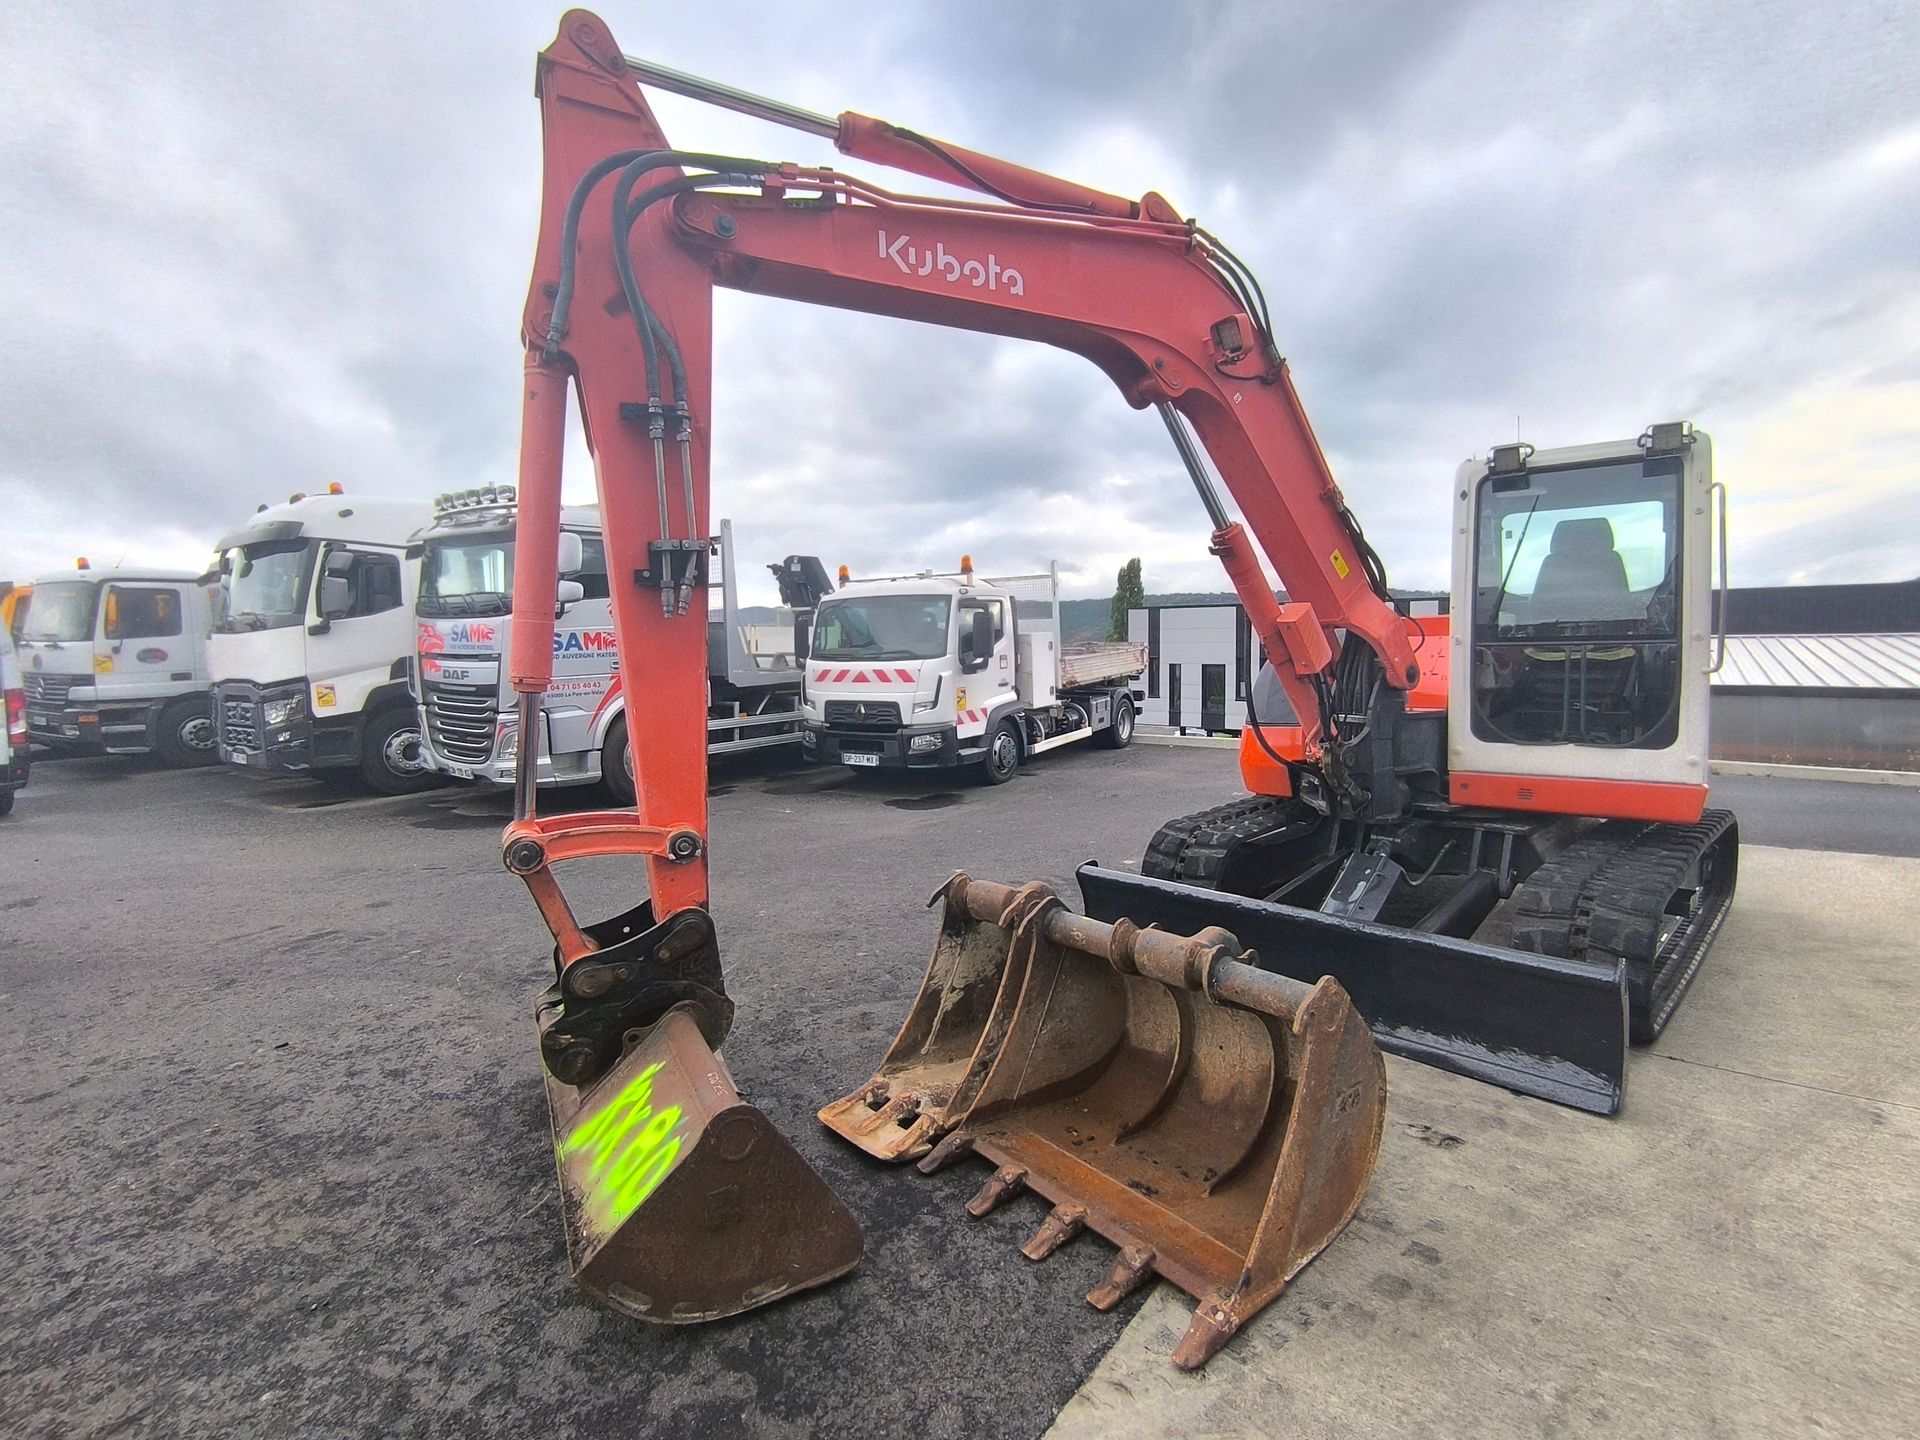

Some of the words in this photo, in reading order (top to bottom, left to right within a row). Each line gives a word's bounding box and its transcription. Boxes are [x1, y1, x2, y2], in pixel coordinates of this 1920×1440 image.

[878, 230, 1024, 296] Kubota
[451, 624, 481, 642] SAM
[562, 652, 594, 660] AUVERGNE
[597, 651, 618, 659] MATERI
[443, 669, 470, 681] DAF
[561, 683, 570, 691] 71
